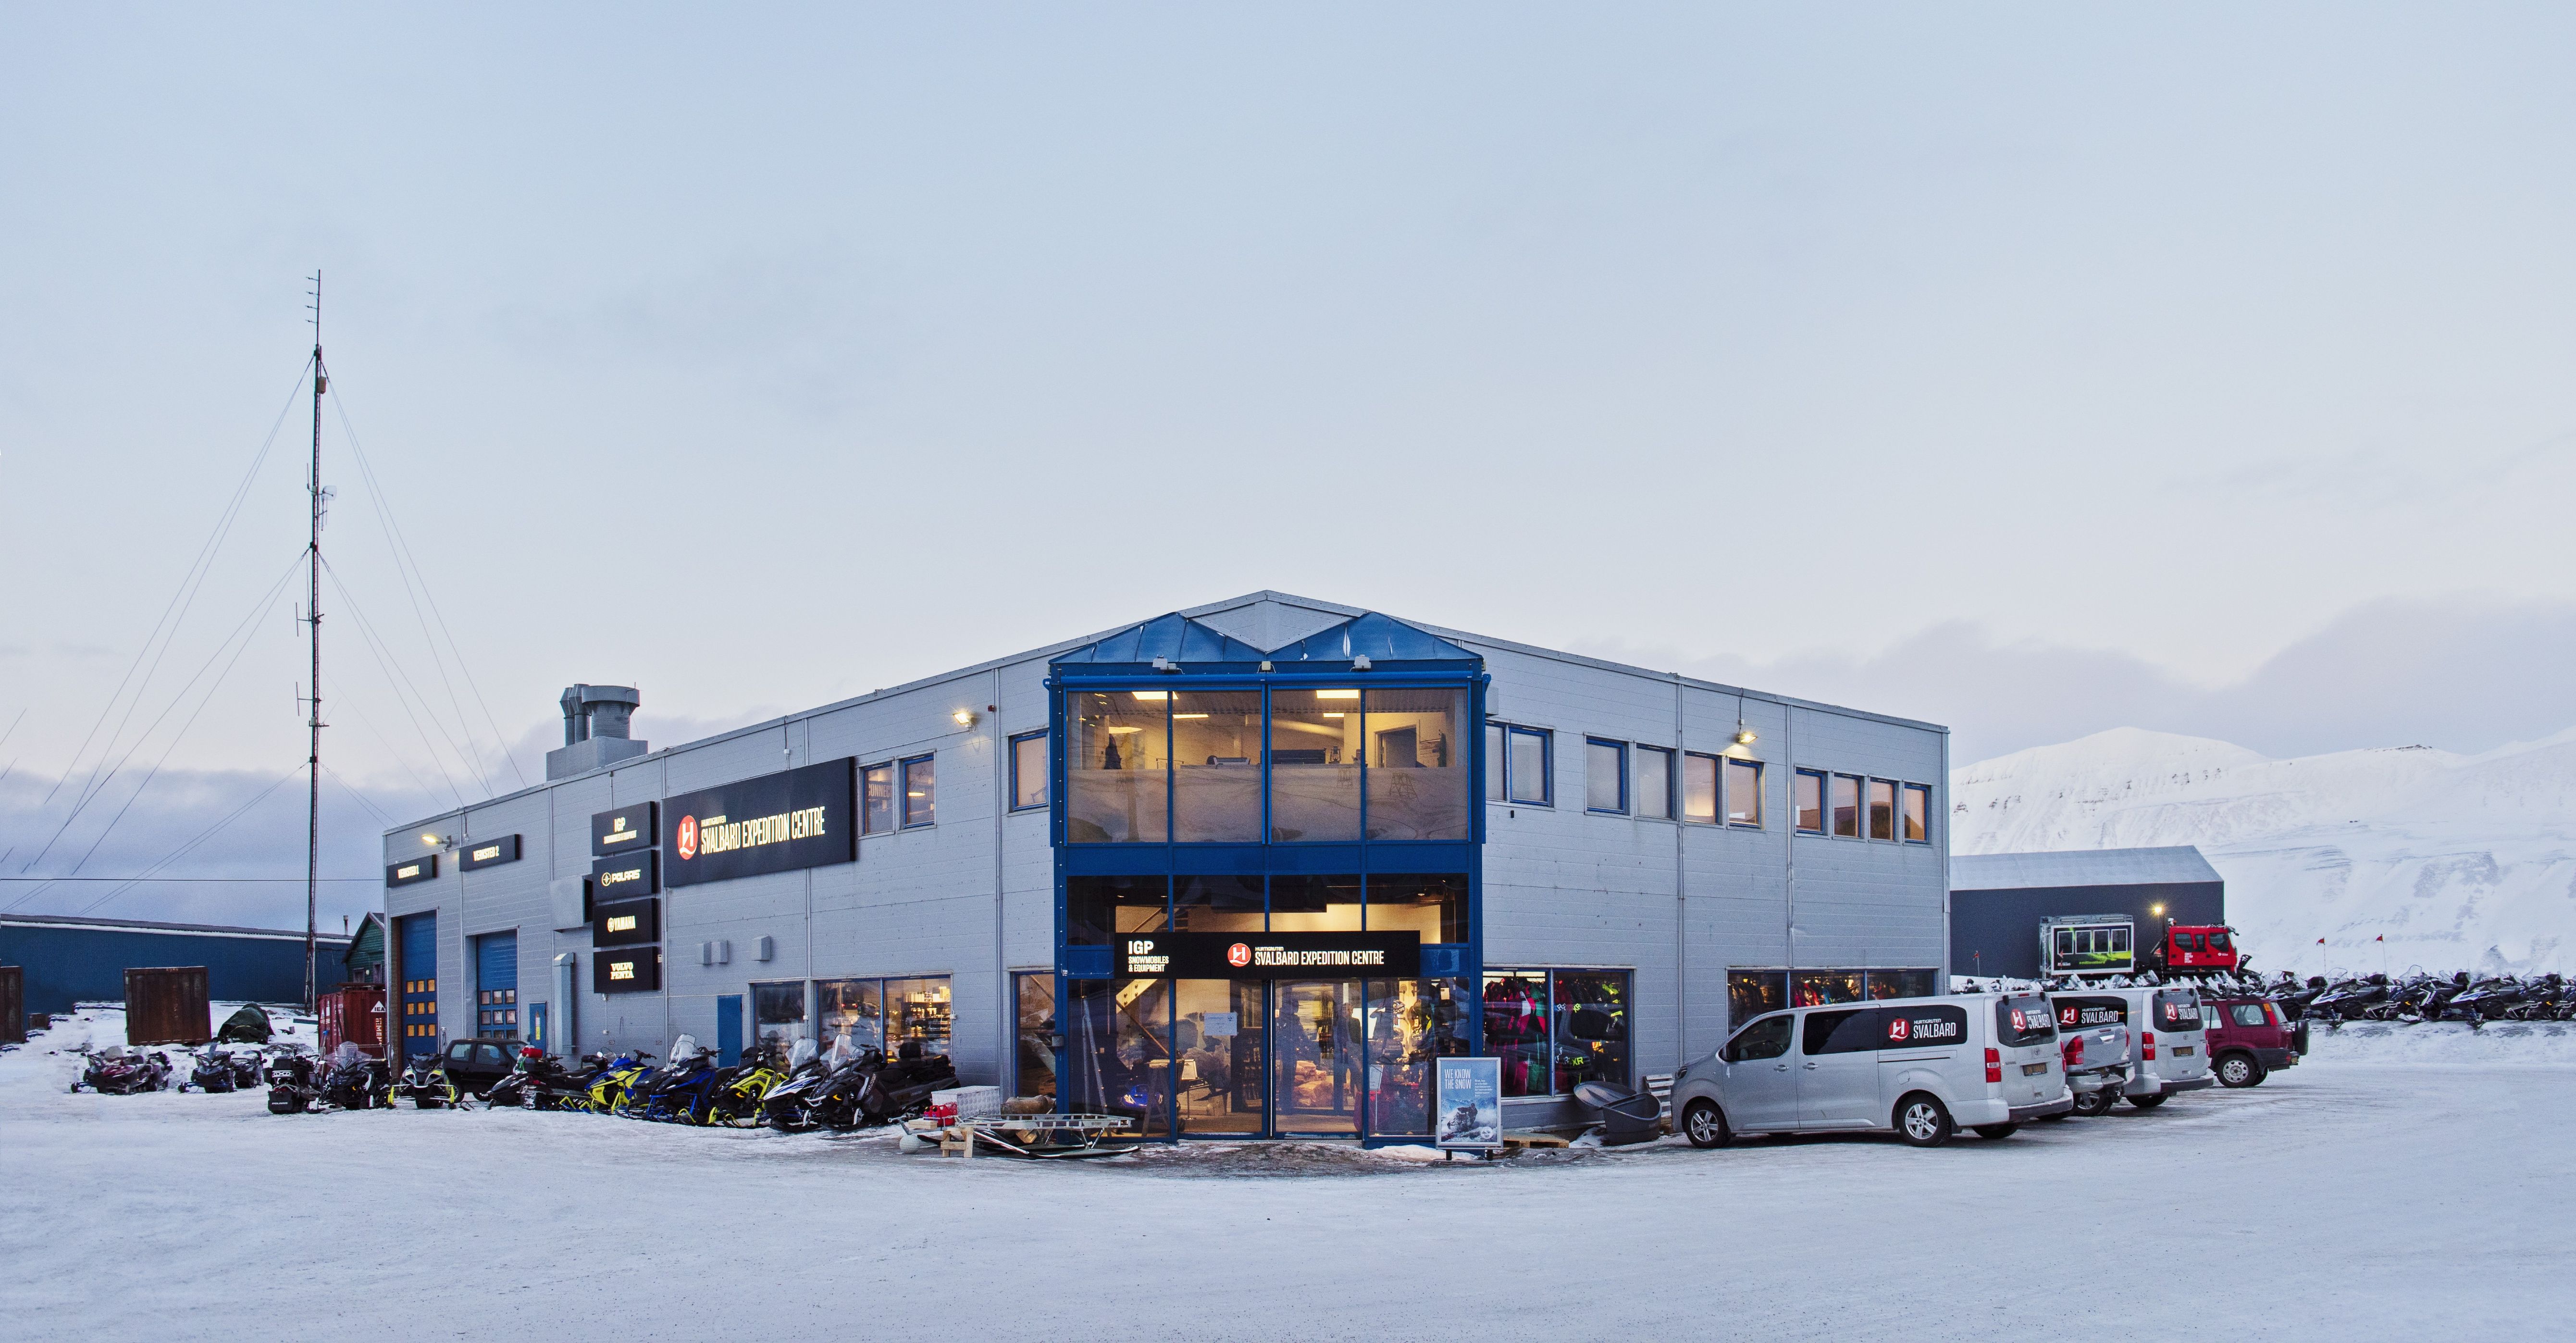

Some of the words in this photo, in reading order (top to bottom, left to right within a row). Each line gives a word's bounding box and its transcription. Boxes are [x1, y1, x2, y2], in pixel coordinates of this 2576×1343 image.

[614, 817, 625, 832] IGP
[701, 822, 741, 855] SVALBARD
[742, 813, 790, 848] EXPEDITION
[792, 806, 825, 839] CENTRE
[473, 846, 495, 861] VERKSTED
[495, 846, 499, 857] 2
[416, 865, 420, 875] 1
[611, 869, 641, 883] POLARIS
[614, 916, 635, 931] YAMAHA
[1128, 941, 1154, 955] IGP
[1128, 956, 1169, 964] SNOWMOBILES
[1255, 951, 1299, 966] SVALBARD
[1301, 951, 1350, 965] EXPEDITION
[1351, 950, 1385, 965] CENTRE
[611, 962, 633, 971] VOLVO
[1128, 964, 1133, 972] &
[1134, 964, 1165, 972] EQUIPMENT
[611, 970, 634, 980] PENTA
[2081, 1011, 2118, 1024] SVALBARD
[2178, 1007, 2198, 1020] SVALBARD
[2027, 1014, 2051, 1029] SVALBARD
[1913, 1022, 1956, 1039] SVALBARD
[1444, 1069, 1453, 1079] WE
[1454, 1069, 1471, 1079] KNOW
[1726, 1066, 1731, 1078] 4
[866, 1073, 877, 1095] POLARIS
[1444, 1079, 1454, 1089] THE
[1455, 1079, 1472, 1089] SNOW
